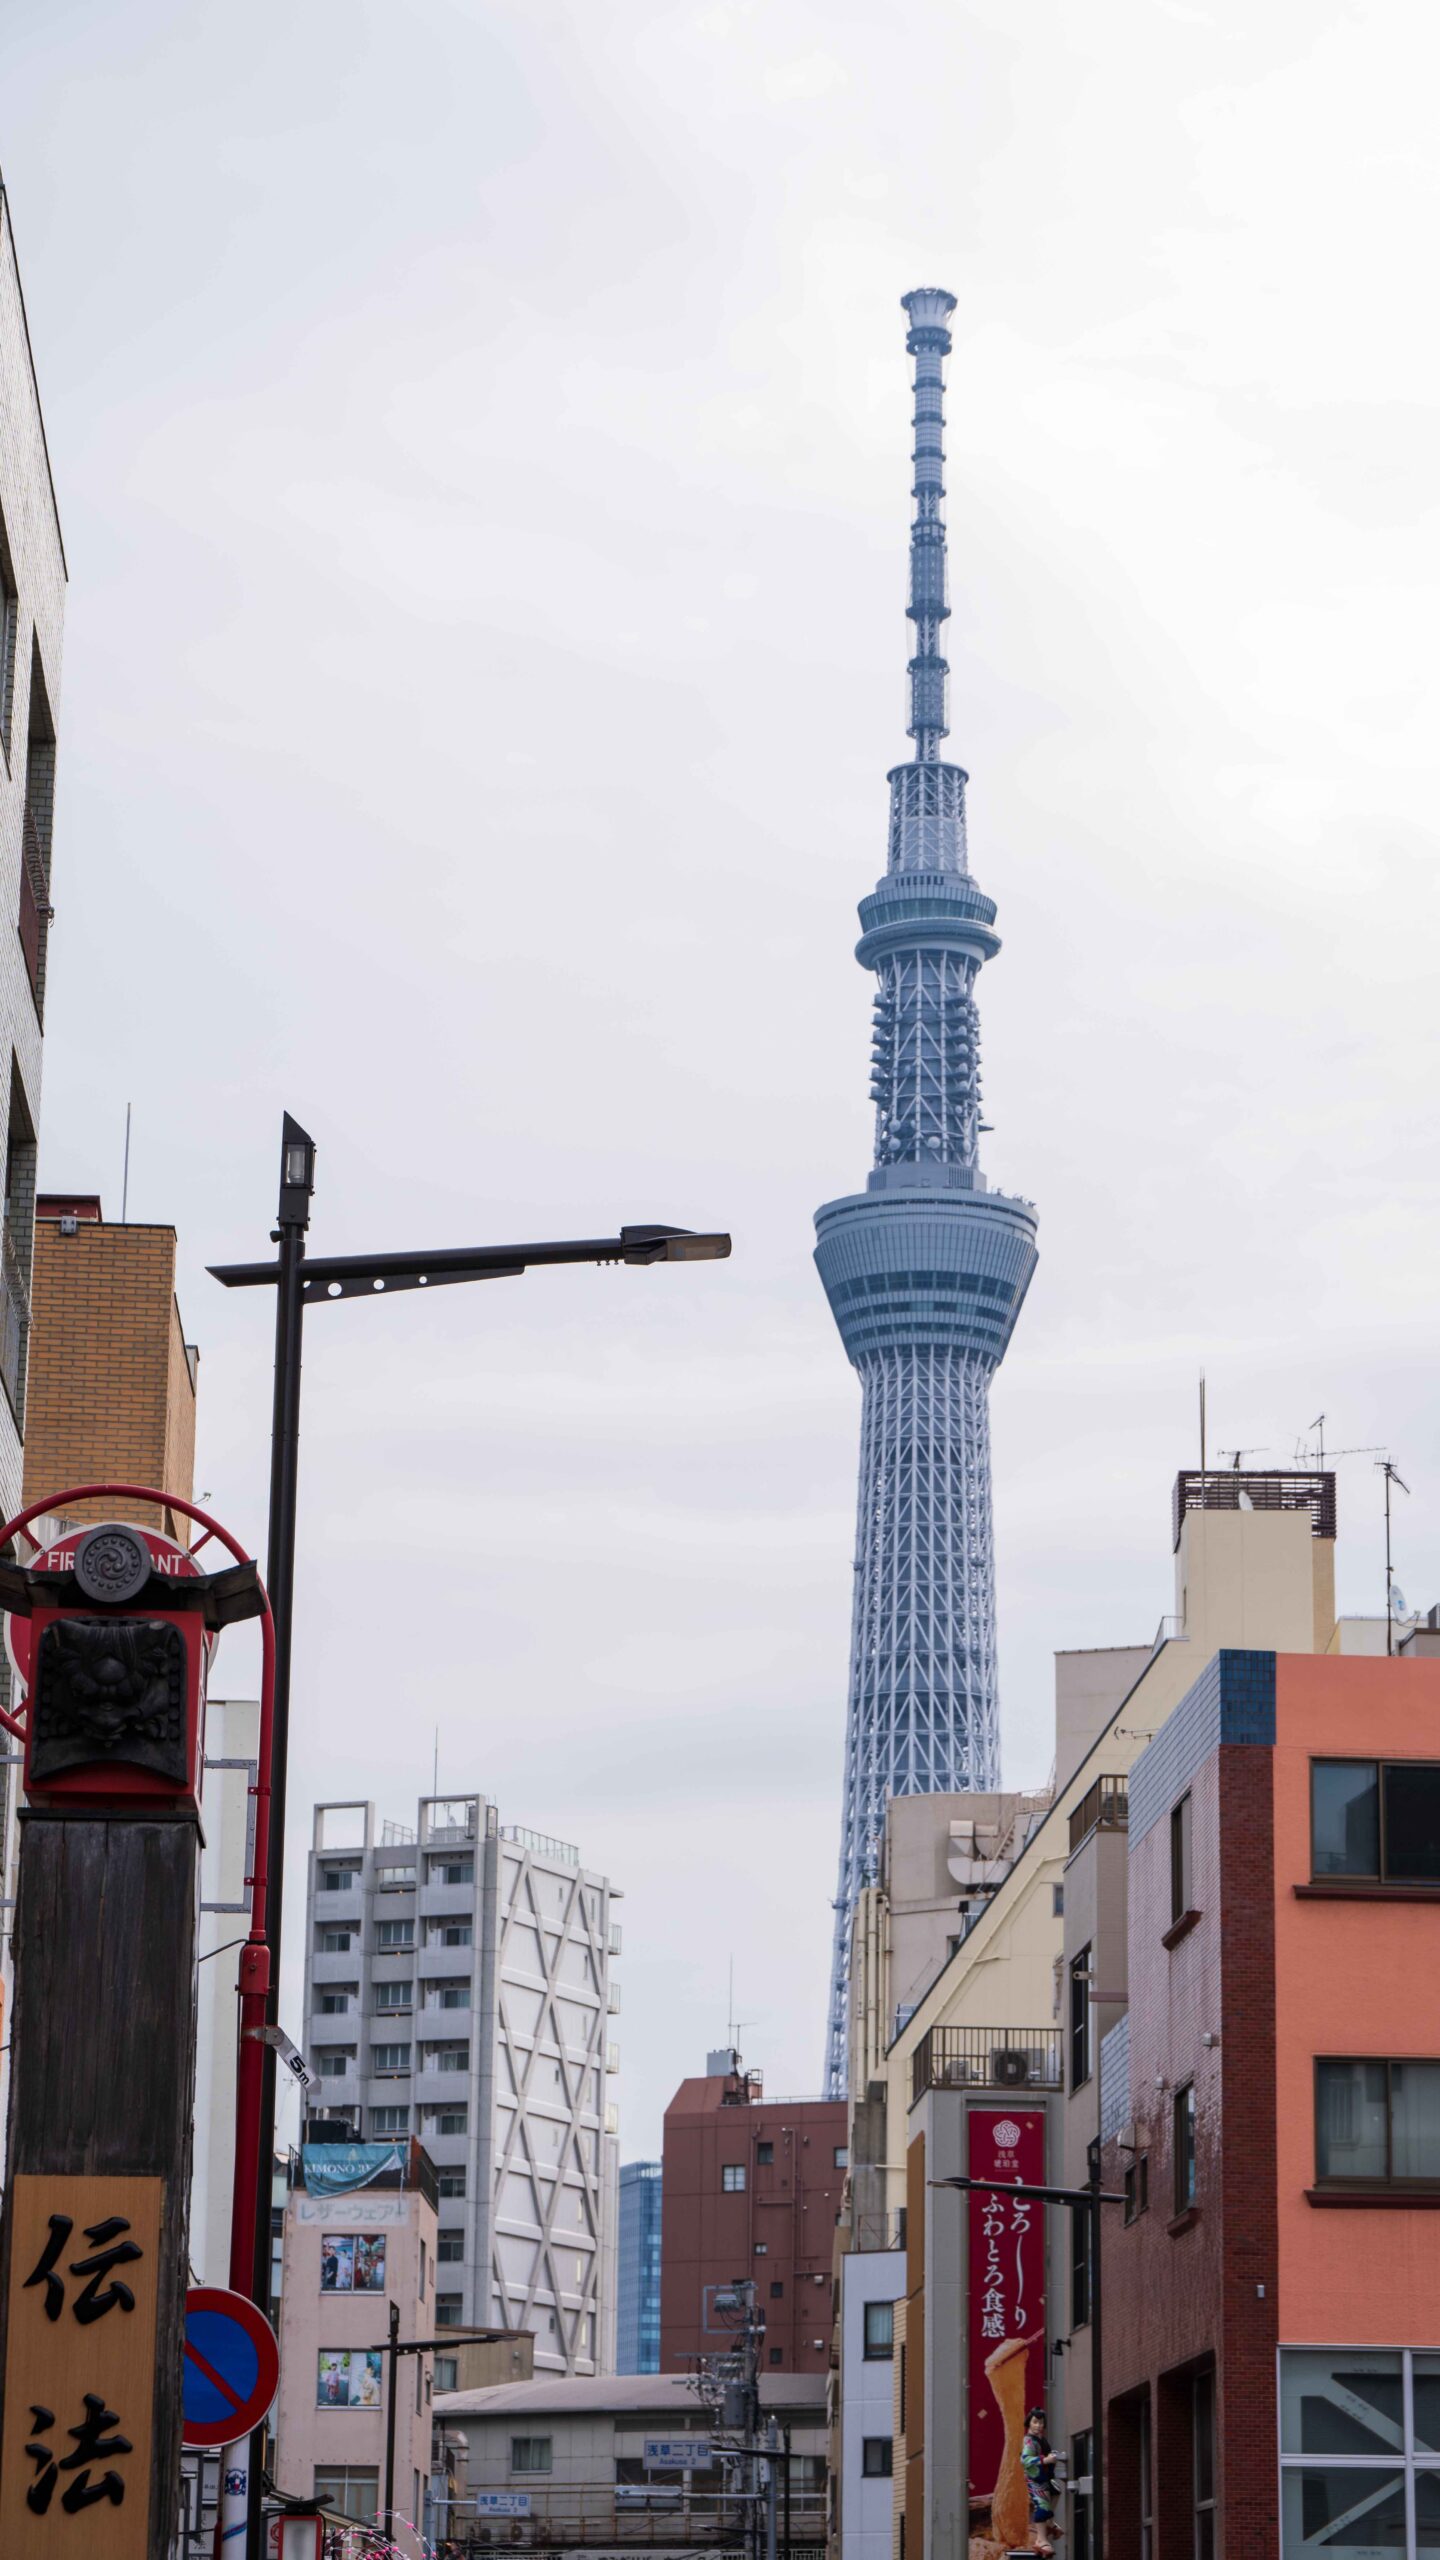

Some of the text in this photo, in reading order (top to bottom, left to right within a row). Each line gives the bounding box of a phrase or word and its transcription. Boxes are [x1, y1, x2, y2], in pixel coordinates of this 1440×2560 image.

[48, 1551, 75, 1572] FIR
[290, 2055, 310, 2085] 5m
[304, 2163, 355, 2174] KIMONO
[981, 2193, 1006, 2338] ふわとろ食感
[23, 2214, 144, 2515] 伝法
[647, 2444, 709, 2457] 浅草二丁目
